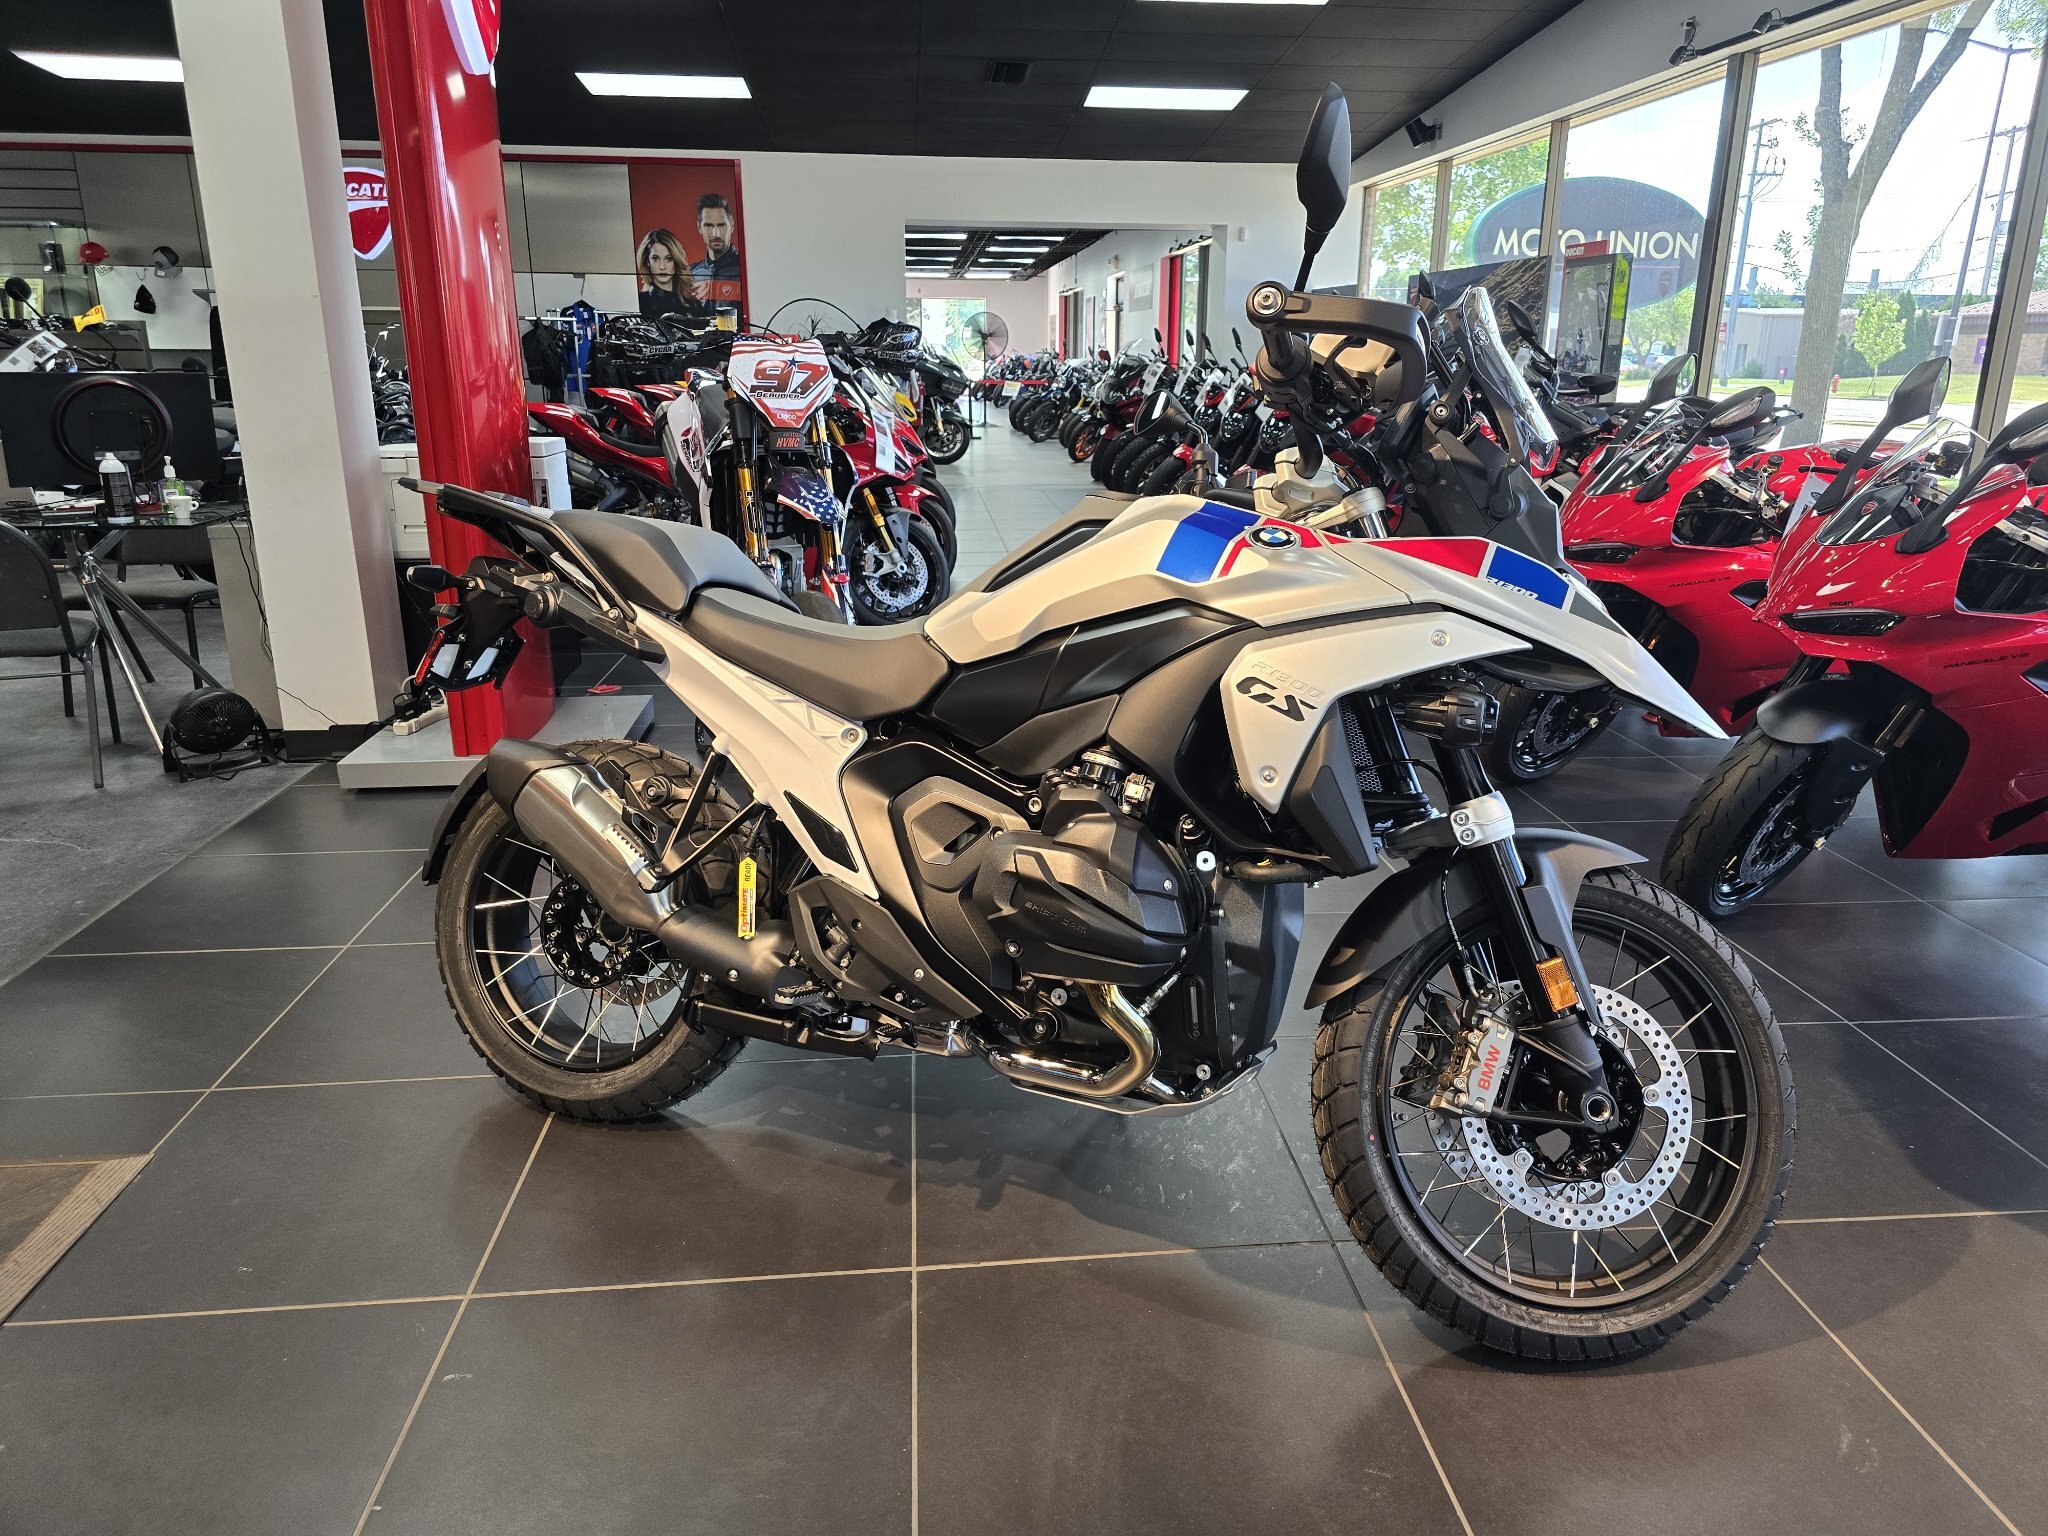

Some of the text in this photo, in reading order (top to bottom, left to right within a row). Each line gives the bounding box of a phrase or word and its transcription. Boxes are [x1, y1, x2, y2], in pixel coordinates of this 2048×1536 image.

[346, 182, 388, 198] CATI
[1493, 228, 1585, 257] MOO
[749, 359, 831, 397] 97
[776, 437, 800, 448] HVMC
[1478, 1044, 1501, 1091] BMW
